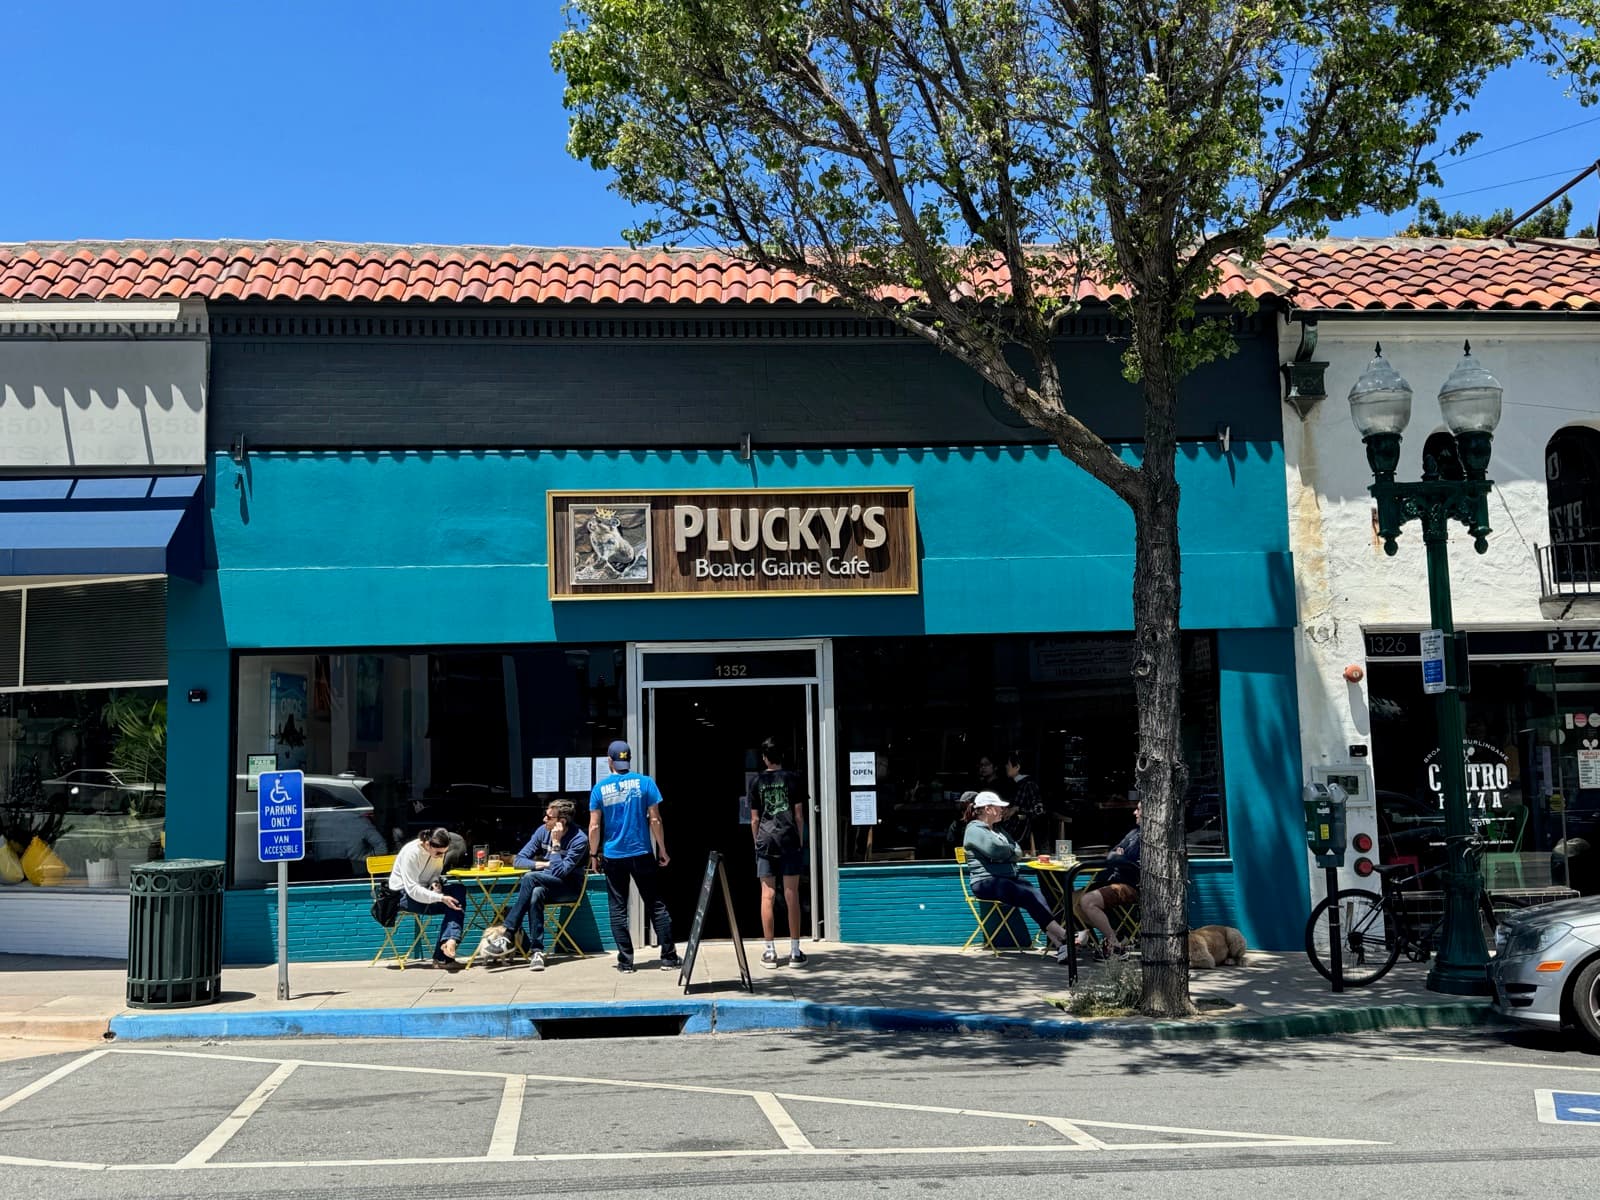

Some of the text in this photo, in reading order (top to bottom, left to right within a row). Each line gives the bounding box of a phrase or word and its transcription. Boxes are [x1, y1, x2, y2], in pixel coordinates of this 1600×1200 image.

[674, 504, 887, 552] PLUCKY'S
[695, 556, 871, 578] Board Game Cafe
[1368, 636, 1407, 653] 1326
[1547, 631, 1600, 651] PIZZ
[715, 665, 747, 677] 1352
[1462, 739, 1510, 762] BURLINGAME
[1428, 763, 1509, 792] CTRO
[600, 782, 617, 795] ONE
[264, 804, 297, 816] PARKING
[271, 817, 291, 828] ONLY
[273, 835, 289, 844] VAN
[264, 845, 299, 855] ACCESSIBLE
